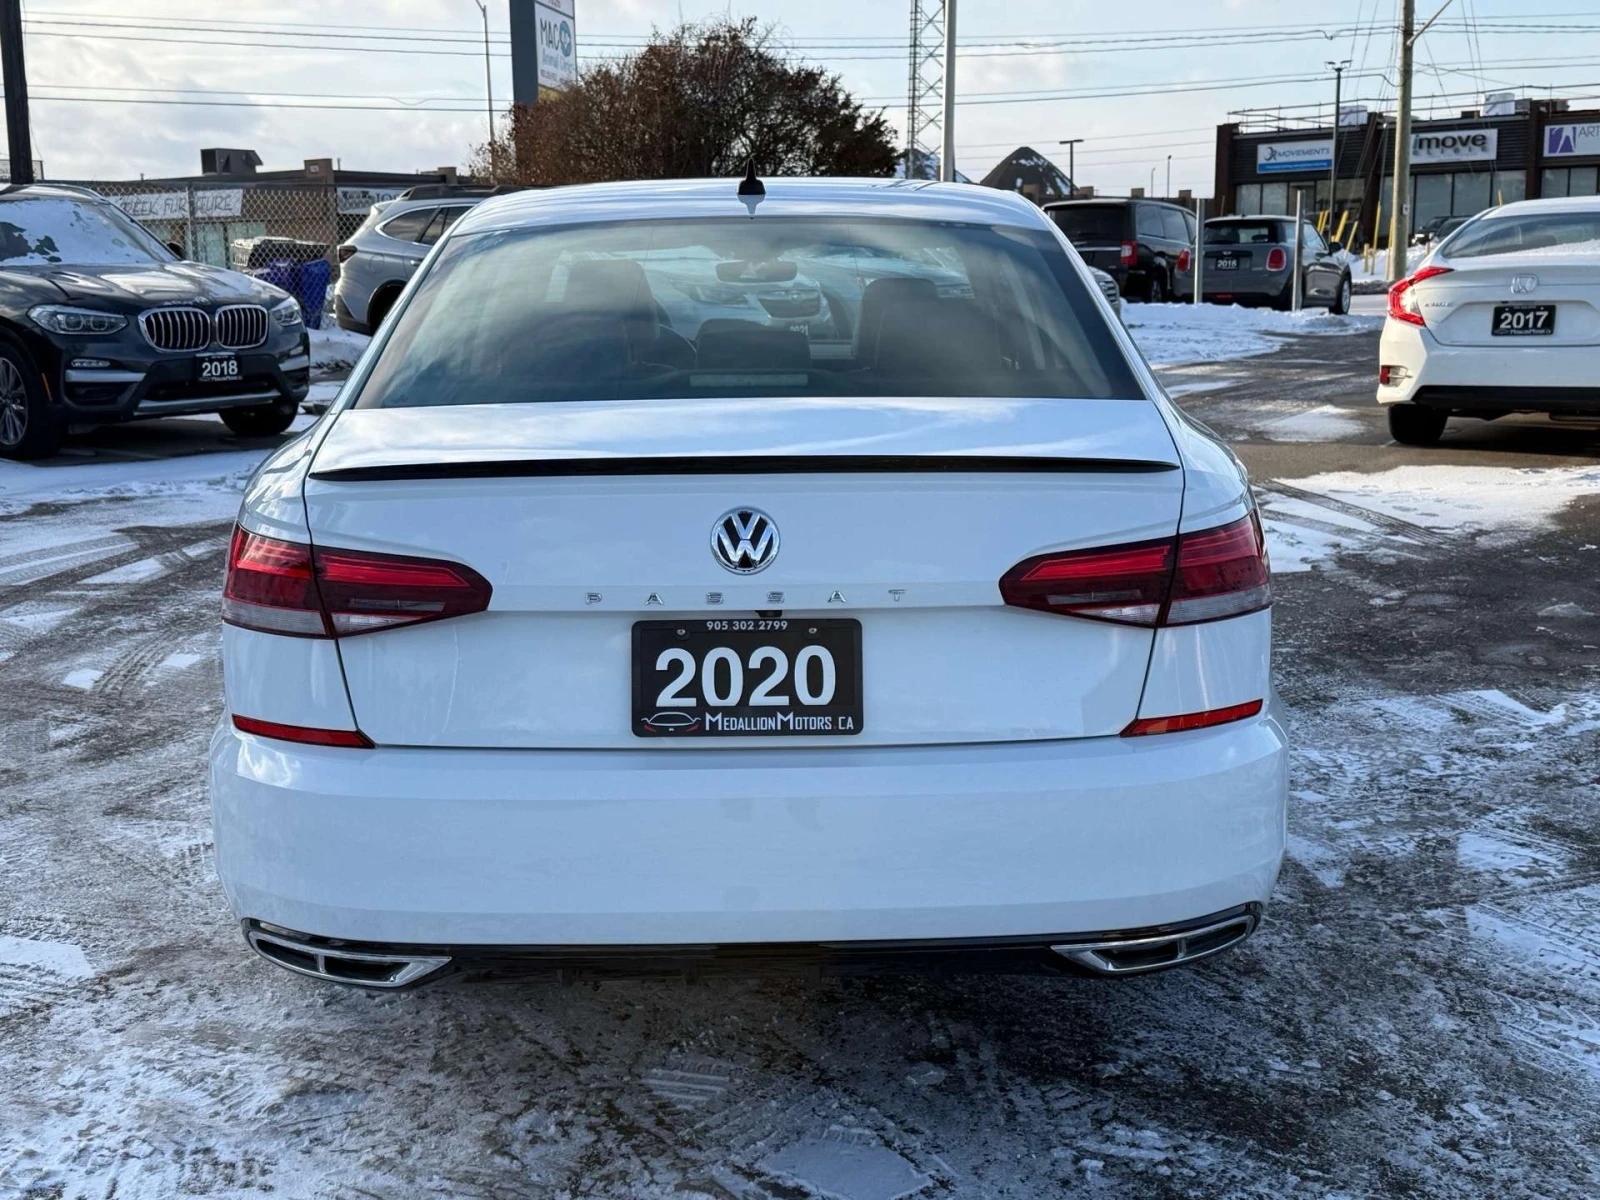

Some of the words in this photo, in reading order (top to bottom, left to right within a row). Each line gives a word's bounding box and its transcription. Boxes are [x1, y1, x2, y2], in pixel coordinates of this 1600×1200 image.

[1412, 134, 1487, 149] imove
[1278, 148, 1330, 157] MOVEMENTS
[1500, 311, 1549, 329] 2017
[202, 360, 238, 377] 2018
[585, 588, 906, 605] PASSAT
[706, 620, 729, 631] 905
[732, 620, 754, 630] 302
[758, 620, 788, 630] 2799
[655, 645, 837, 708] 2020
